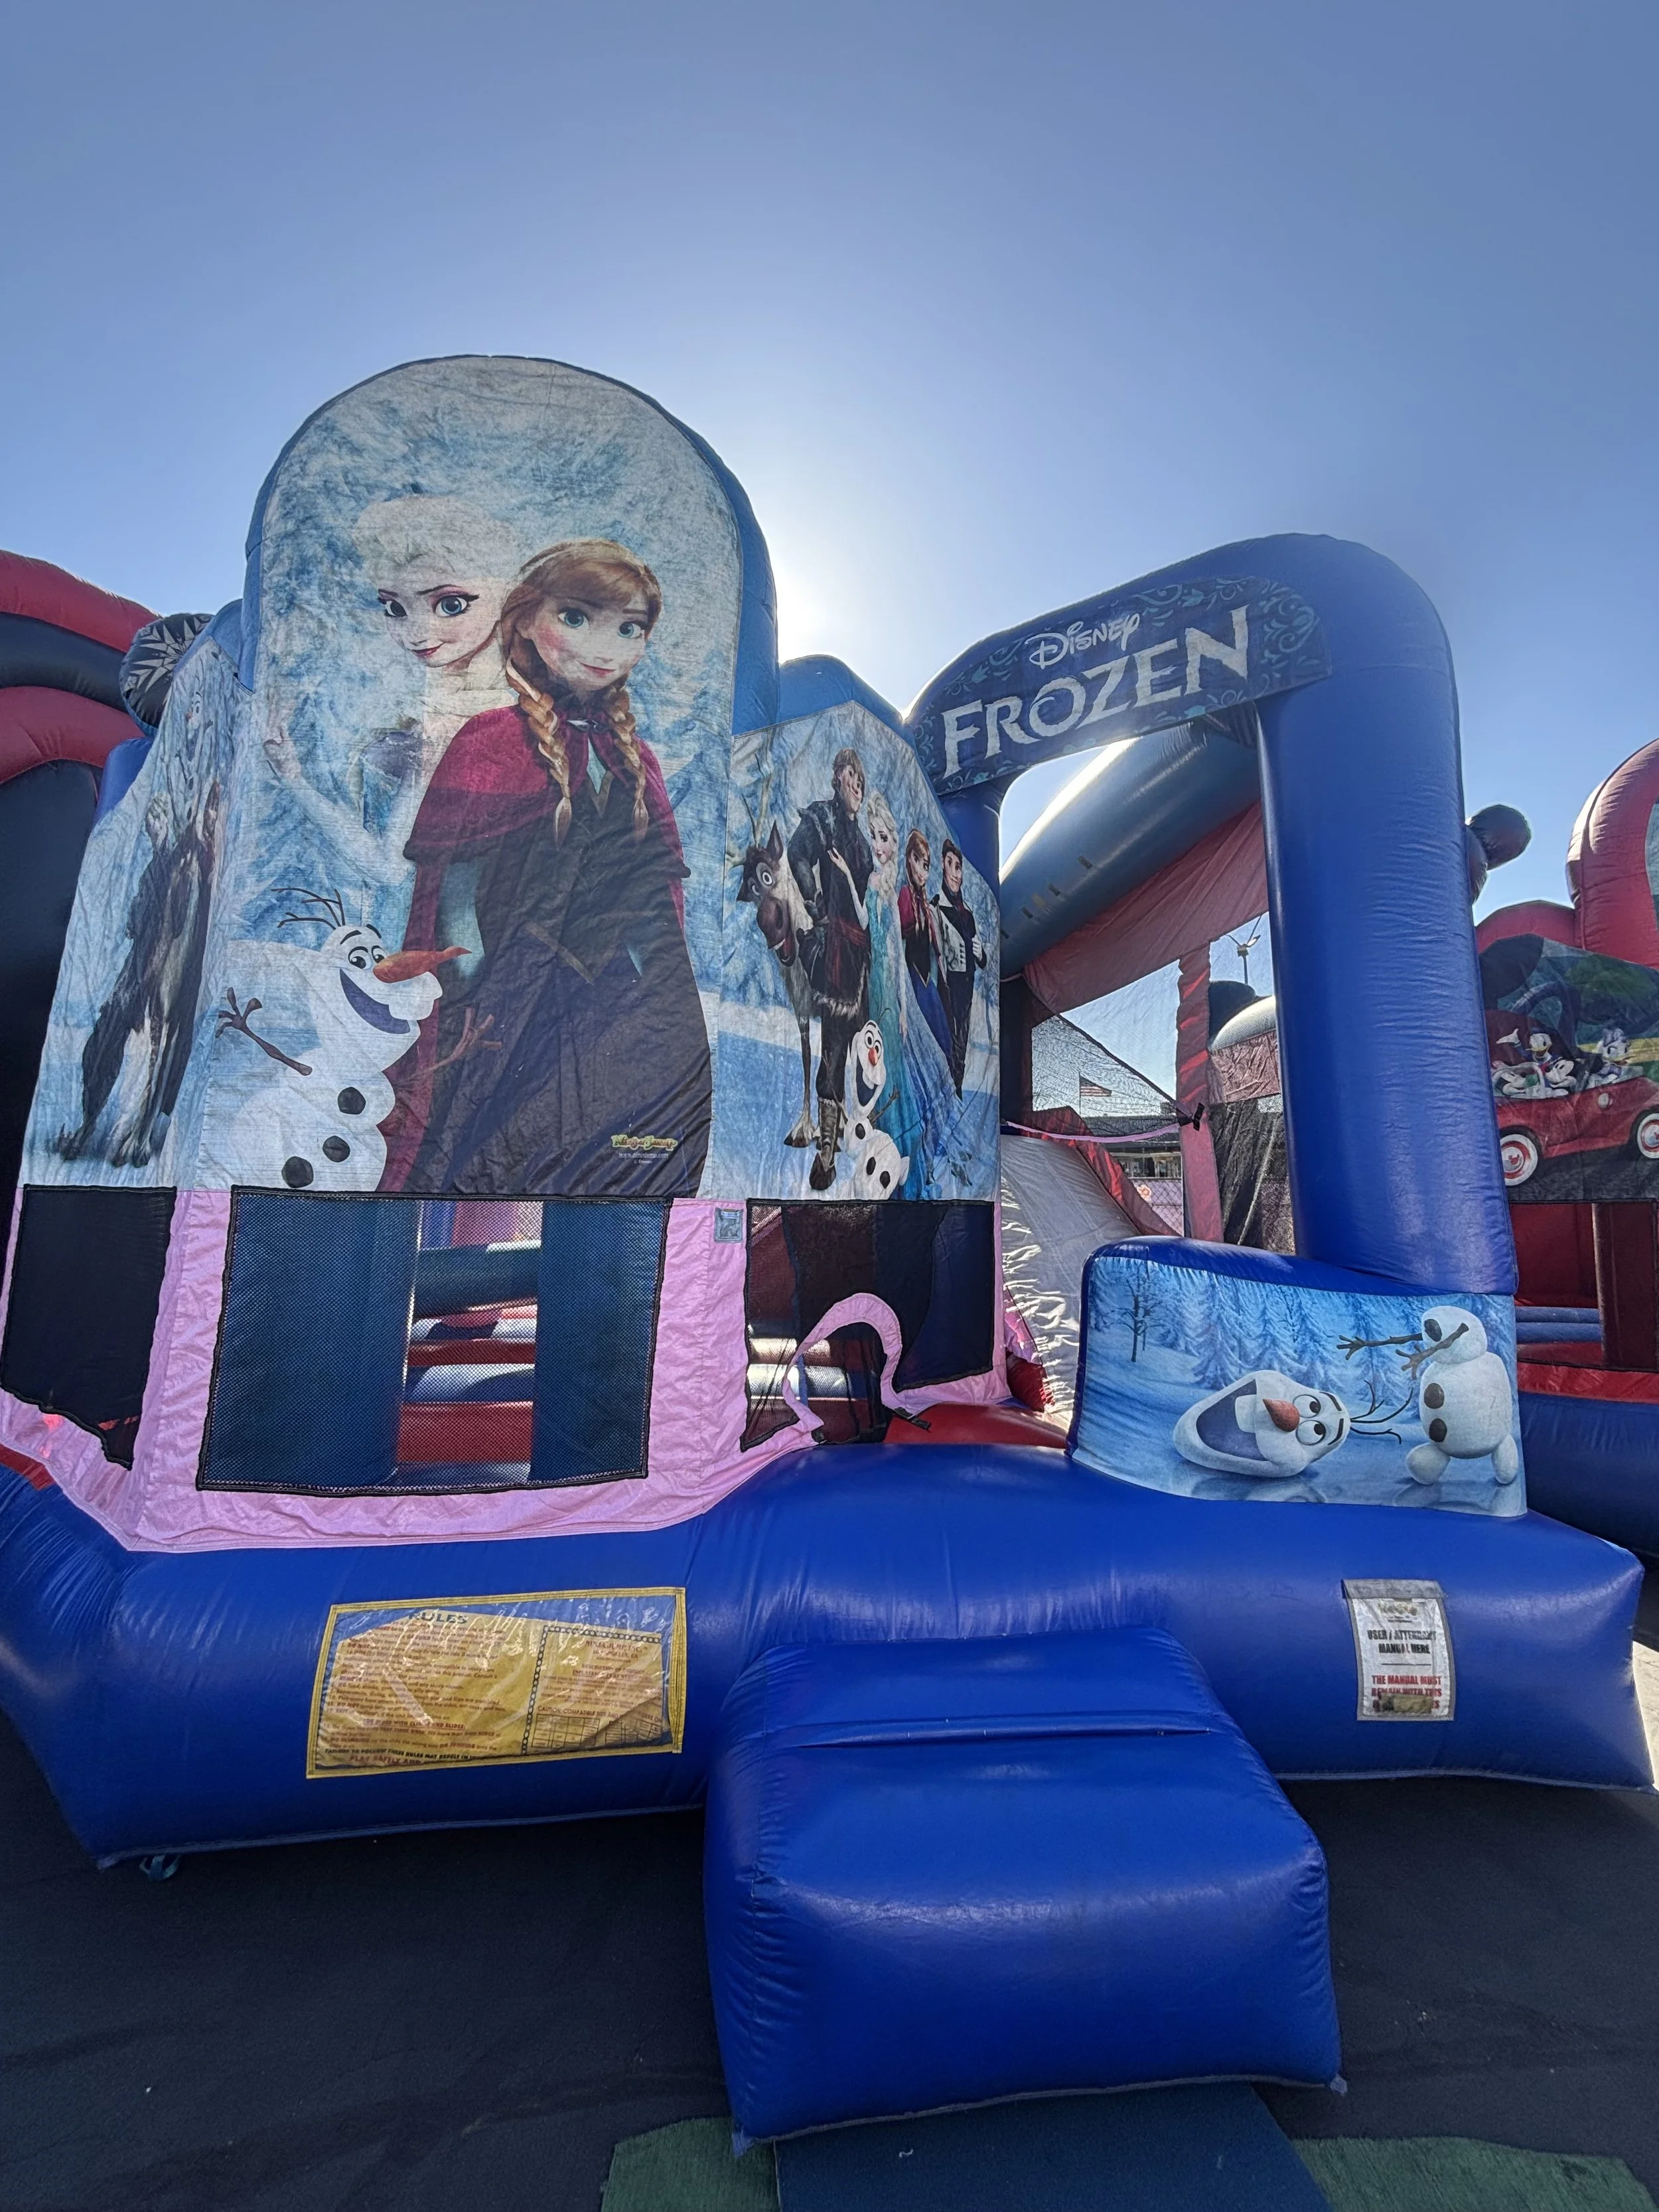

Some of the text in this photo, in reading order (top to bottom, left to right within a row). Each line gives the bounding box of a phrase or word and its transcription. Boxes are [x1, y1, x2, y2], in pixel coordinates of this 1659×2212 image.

[1025, 613, 1140, 668] Disney
[941, 605, 1250, 778] FROZEN
[1367, 1629, 1387, 1640] USER
[1378, 1643, 1431, 1654] MANUAL HERE
[1372, 1675, 1442, 1685] THE MANUAL MUST
[1425, 1688, 1443, 1697] THIS
[373, 1755, 401, 1765] SAFELY
